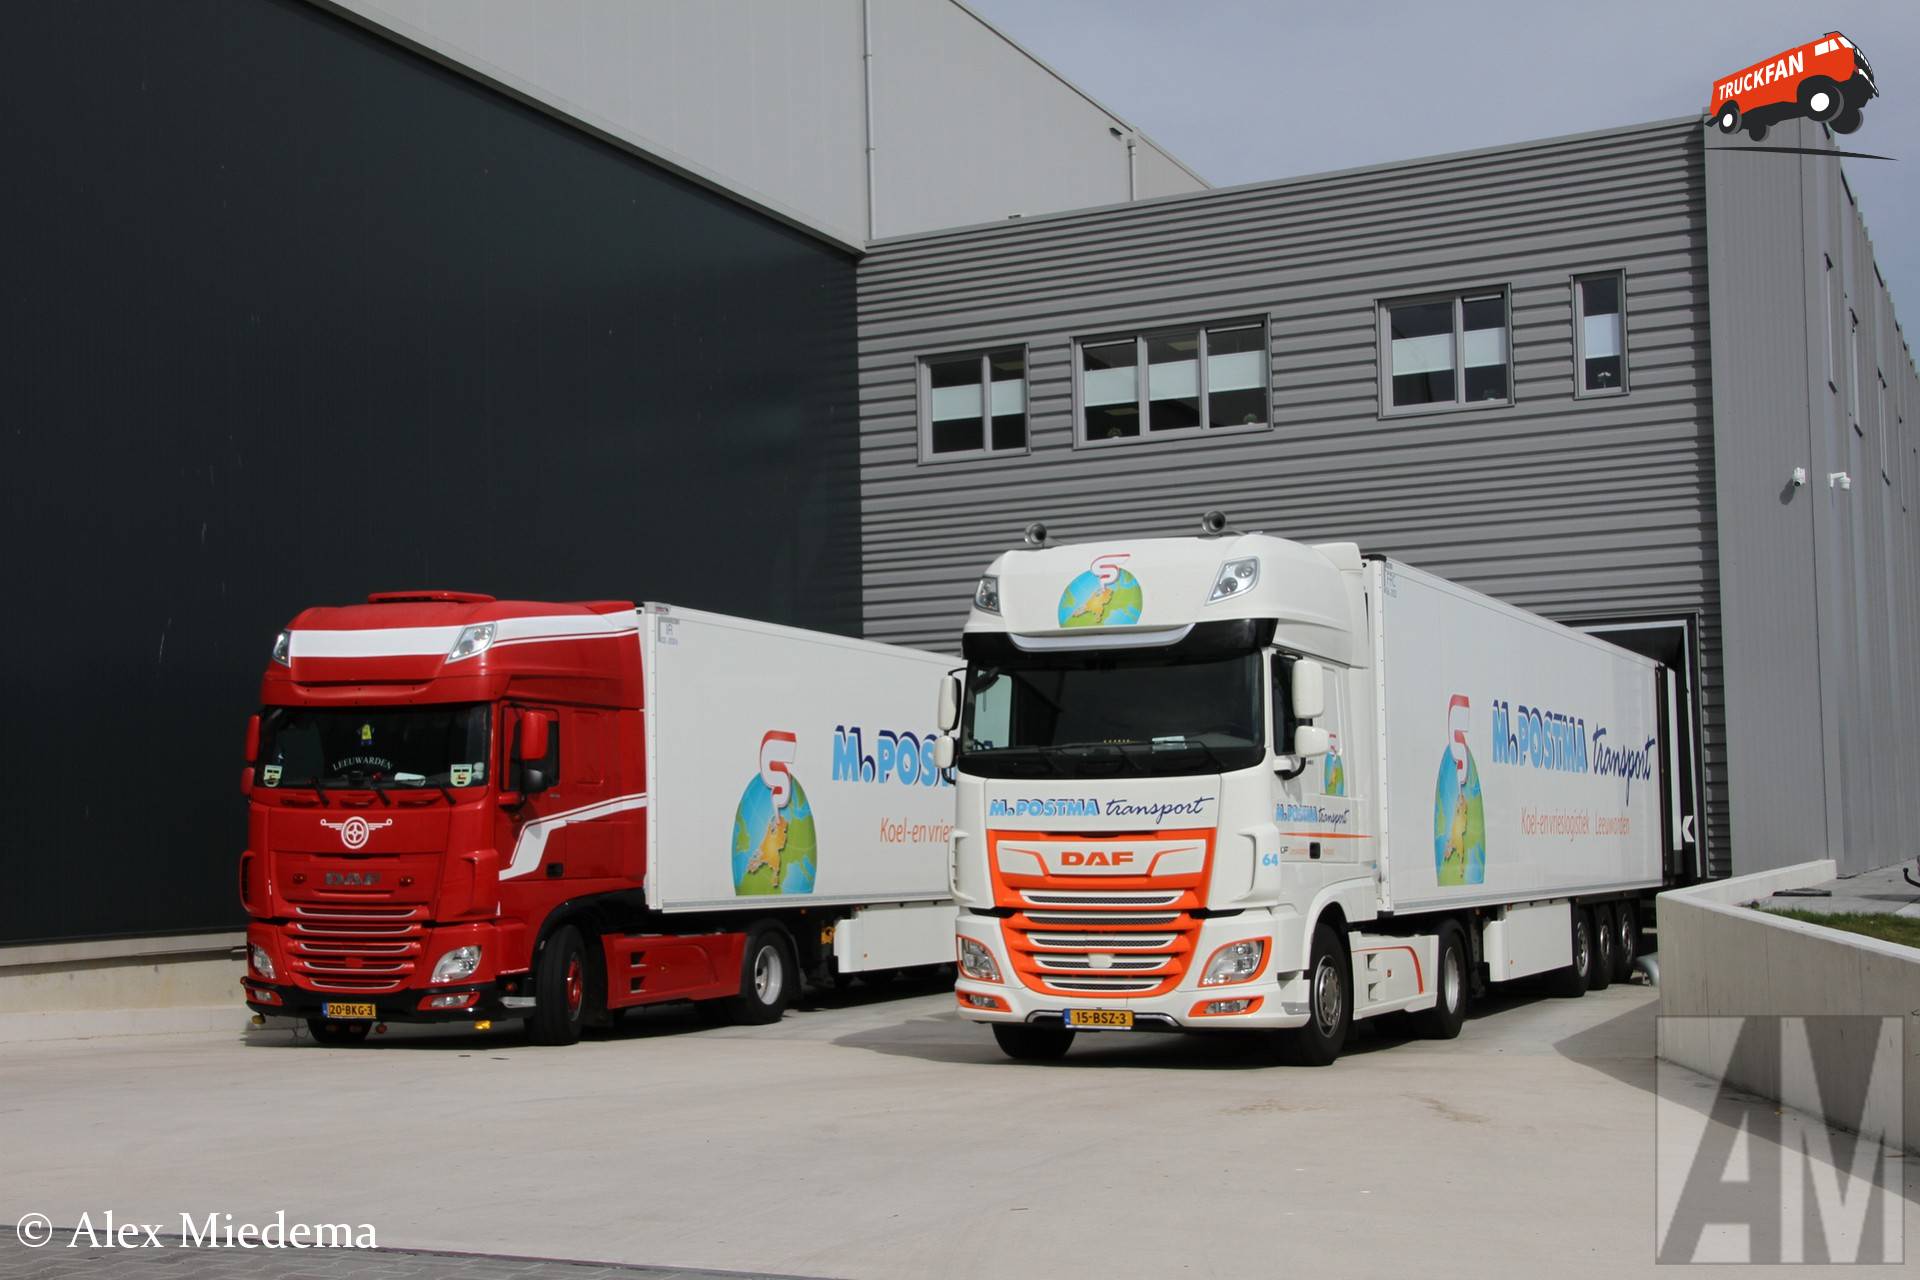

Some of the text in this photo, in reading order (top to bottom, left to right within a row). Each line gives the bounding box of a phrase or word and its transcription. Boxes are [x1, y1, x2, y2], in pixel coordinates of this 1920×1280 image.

[1593, 724, 1655, 807] transport
[1106, 797, 1214, 824] transport
[1061, 852, 1133, 866] DAF
[1262, 853, 1279, 867] 64
[324, 871, 381, 886] DAF
[329, 1004, 373, 1016] 20-BKG-3
[1076, 1012, 1126, 1024] 15-BSZ-3
